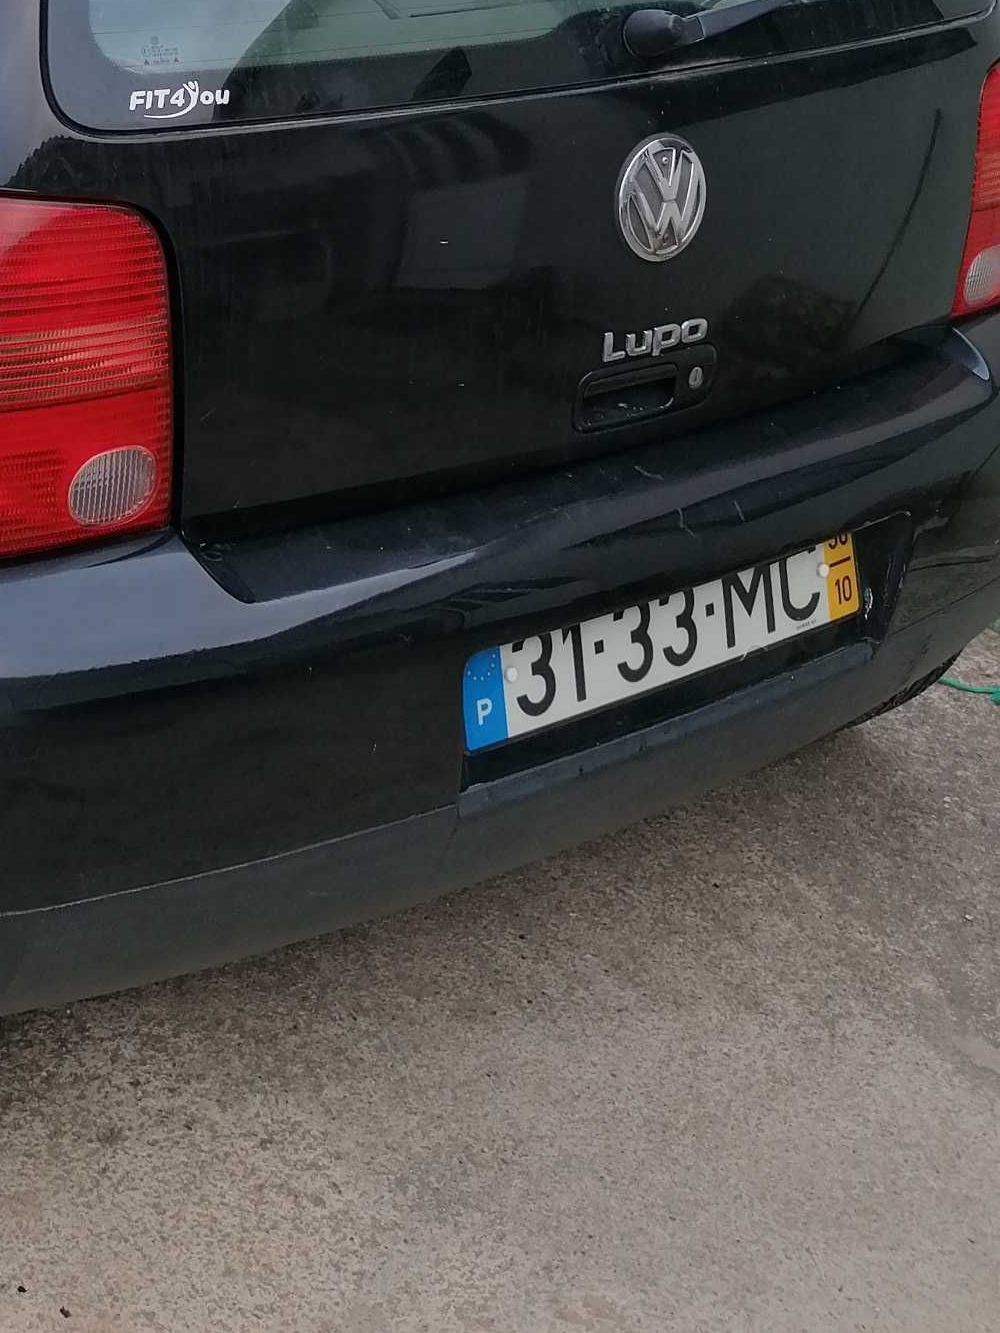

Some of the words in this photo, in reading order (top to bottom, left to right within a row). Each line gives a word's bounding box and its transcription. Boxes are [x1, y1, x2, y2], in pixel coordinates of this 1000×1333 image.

[834, 575, 853, 605] 10
[511, 544, 821, 717] 31-33-MC
[476, 697, 494, 727] P
